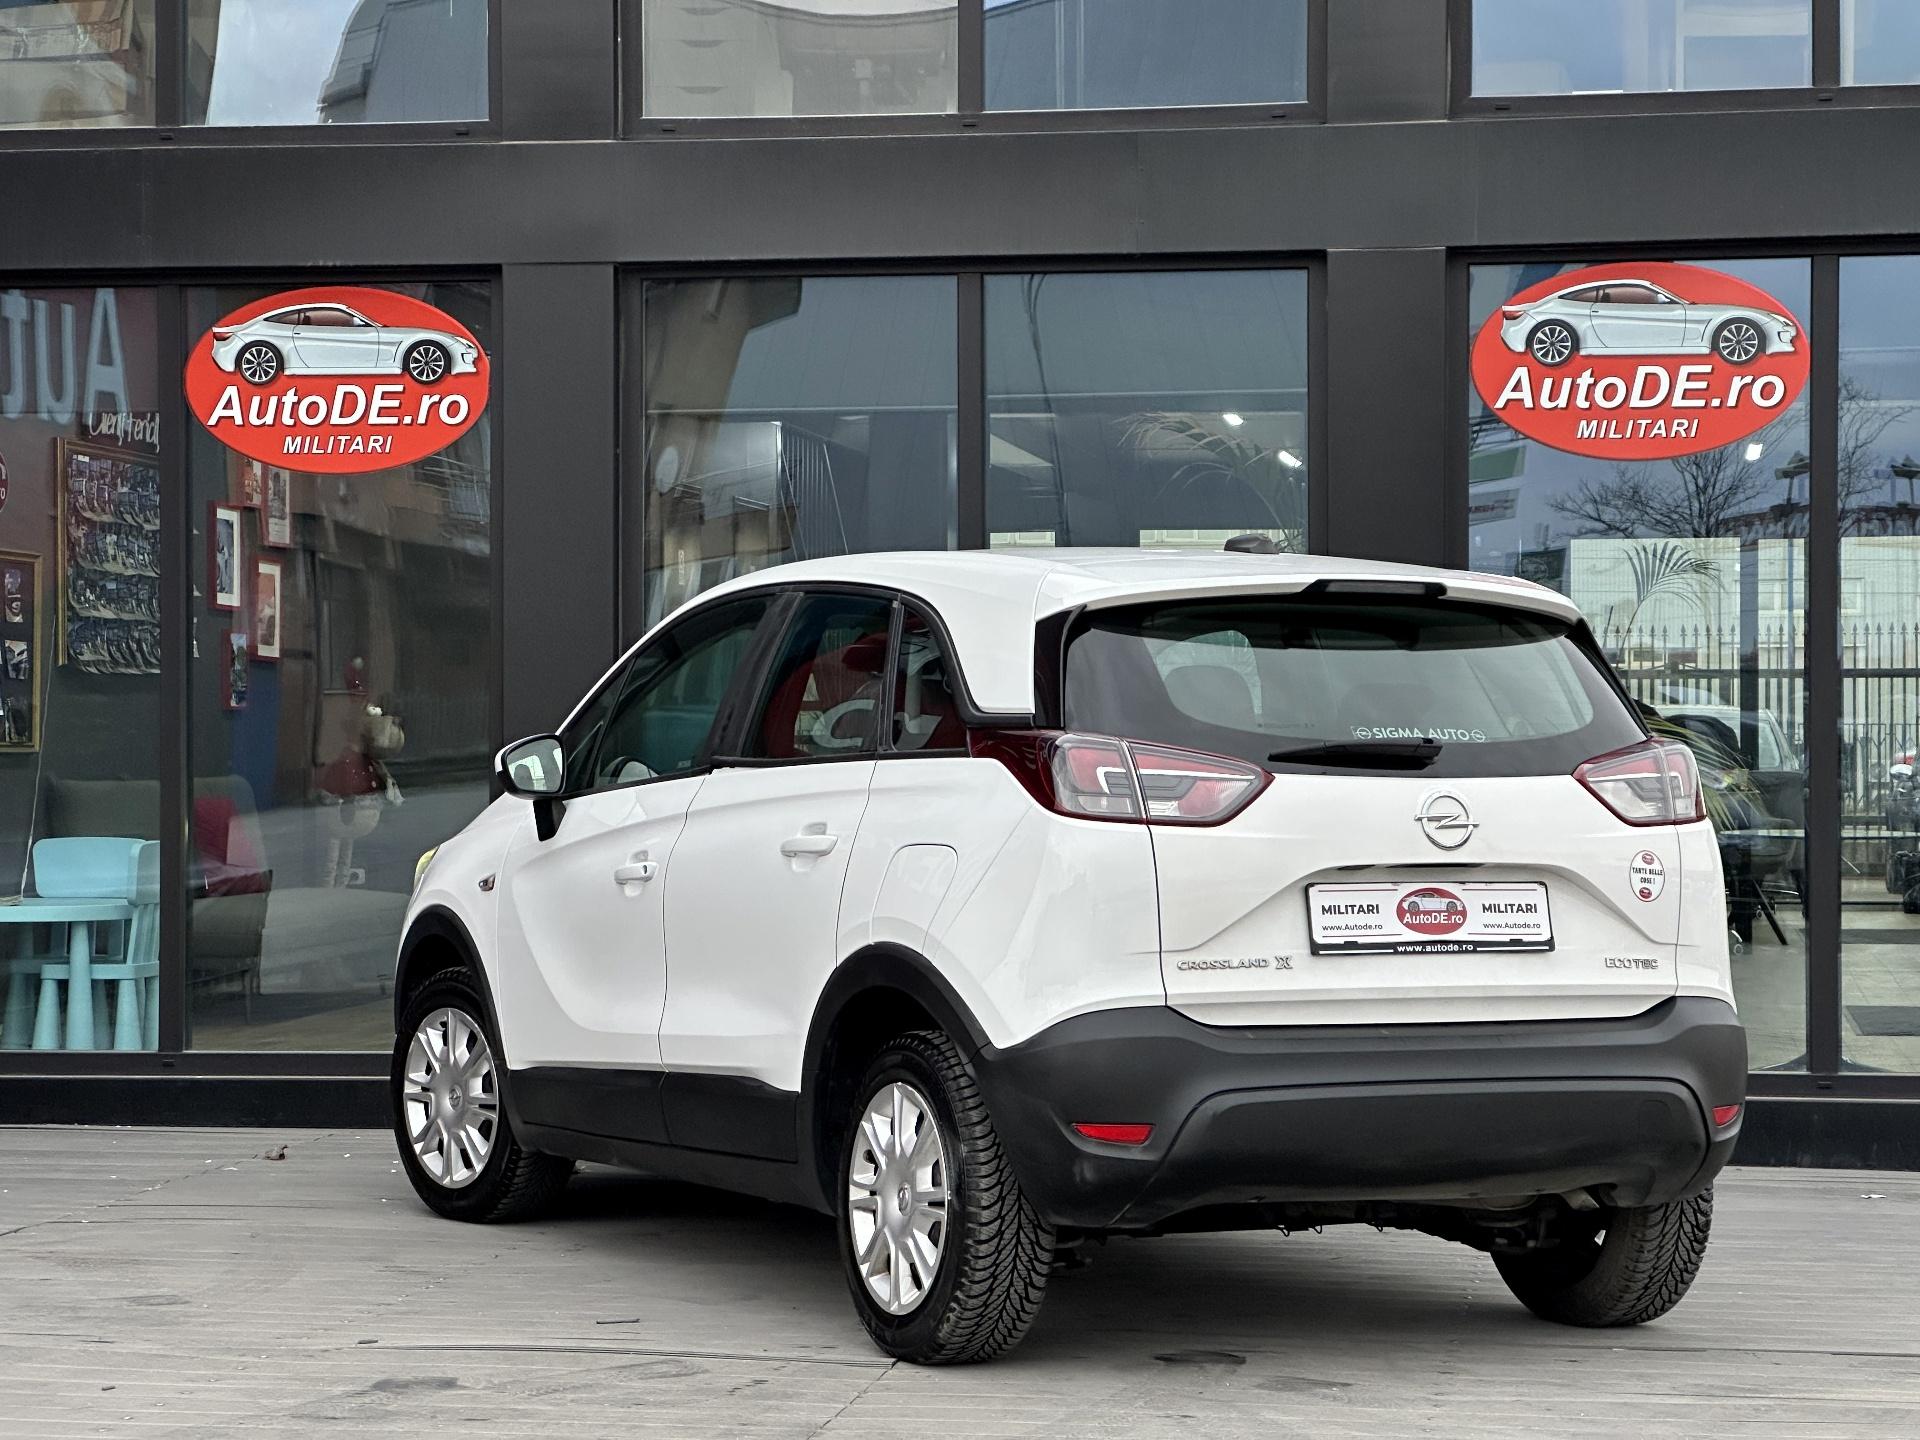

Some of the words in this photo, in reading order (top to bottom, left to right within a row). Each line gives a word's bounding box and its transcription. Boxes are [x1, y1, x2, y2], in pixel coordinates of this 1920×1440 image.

[1493, 364, 1786, 410] AutoDE.ro
[207, 384, 470, 427] AutoDE.ro
[1576, 419, 1699, 439] MILITARI
[283, 435, 393, 454] MILITARI
[1372, 727, 1424, 739] SIGMA
[1428, 728, 1470, 741] AUTO
[1648, 868, 1663, 876] BELLE
[1321, 904, 1380, 915] MILITARI
[1482, 903, 1538, 914] MILITARI
[1403, 912, 1464, 924] AutoDE.ro
[1322, 923, 1383, 931] www.Autode.ro
[1483, 921, 1541, 929] www.Autode.ro
[1397, 943, 1474, 952] www.autode.ro
[1177, 958, 1270, 970] CROSSLAND
[1605, 957, 1659, 970] ECOTEC
